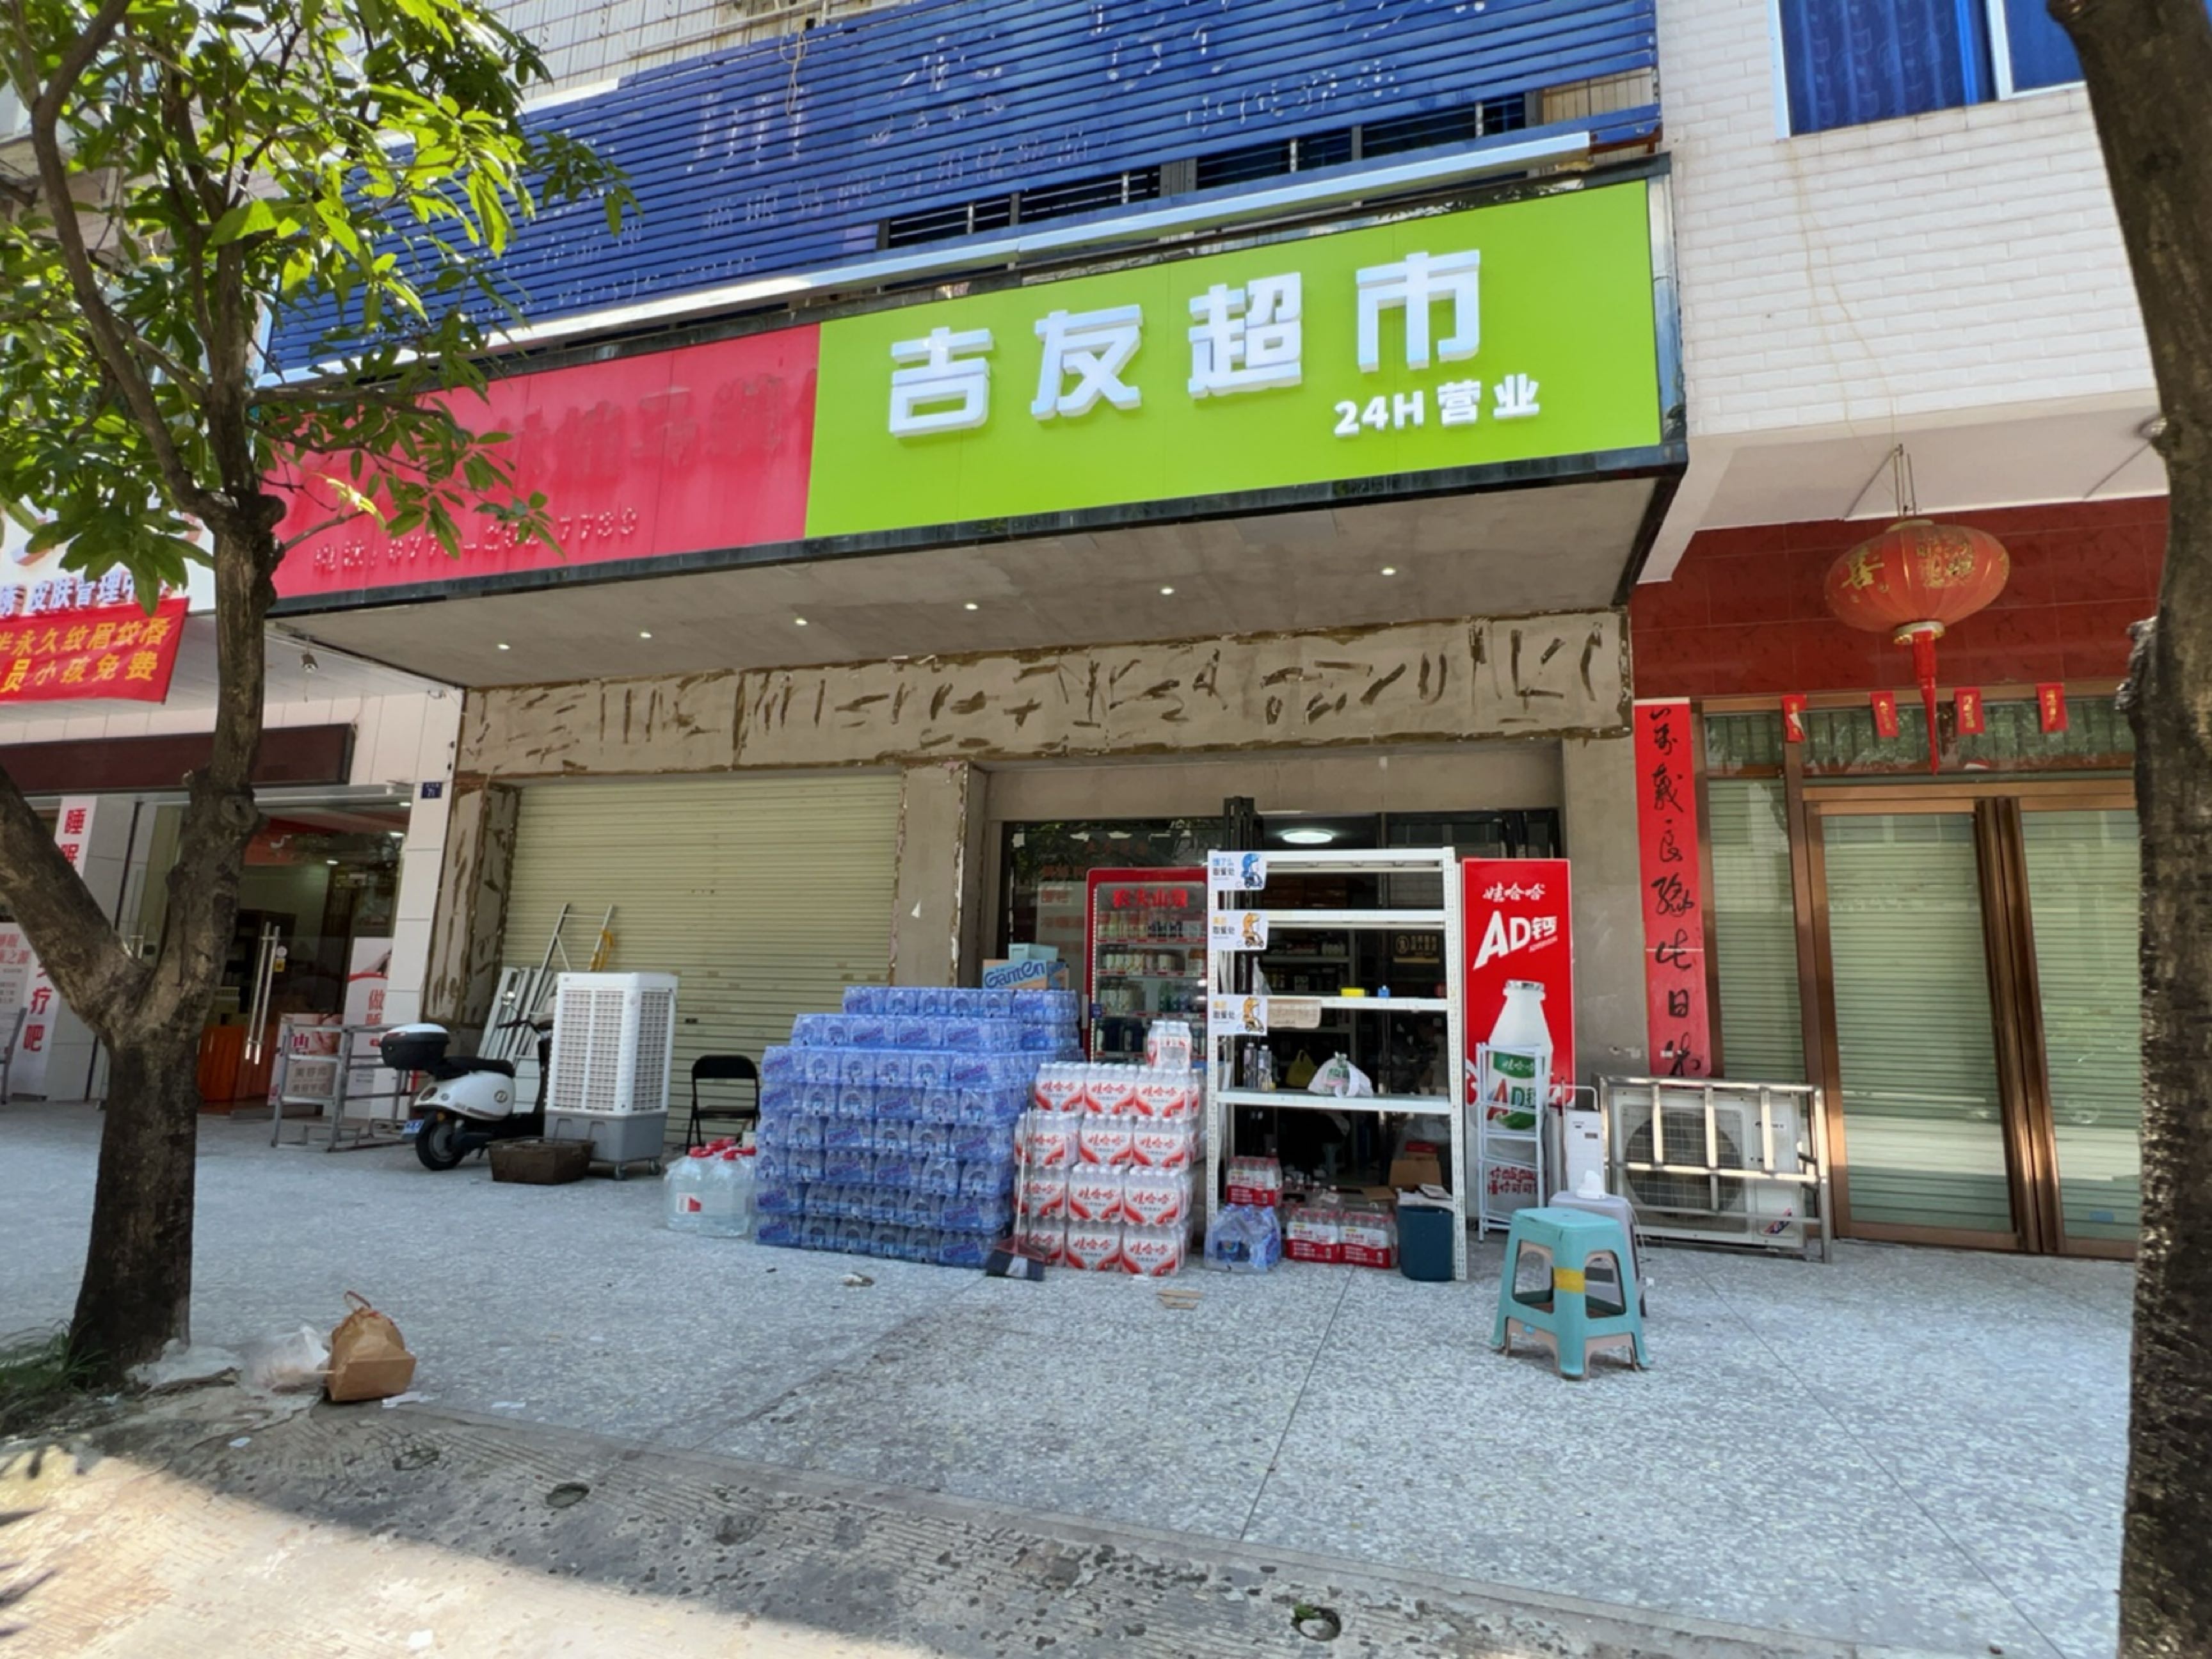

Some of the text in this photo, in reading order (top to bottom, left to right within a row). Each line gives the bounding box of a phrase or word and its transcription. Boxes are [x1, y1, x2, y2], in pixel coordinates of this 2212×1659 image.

[889, 250, 1482, 438] 吉友超市
[1334, 373, 1541, 438] 24H营业
[0, 650, 158, 693] 员小孩免费
[1482, 881, 1546, 903] 娃哈哈
[1473, 910, 1558, 971] AD钙
